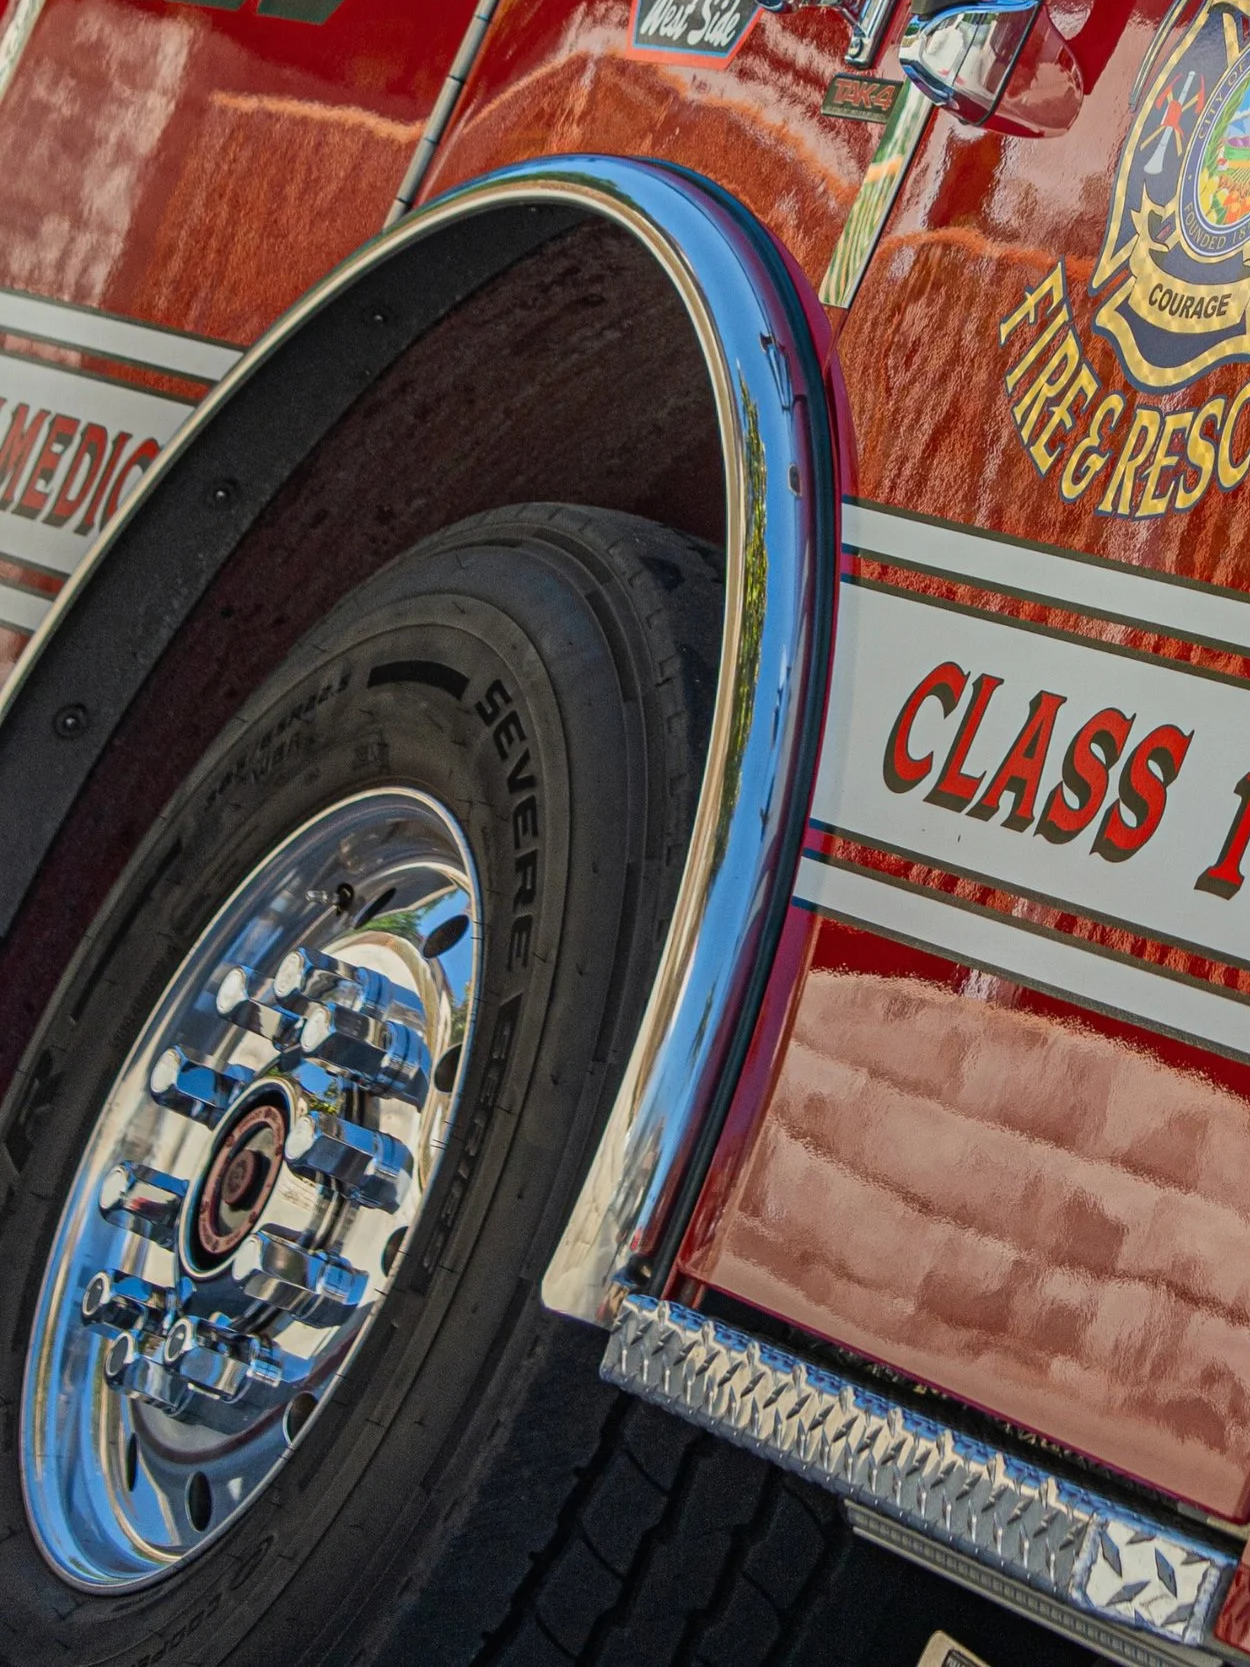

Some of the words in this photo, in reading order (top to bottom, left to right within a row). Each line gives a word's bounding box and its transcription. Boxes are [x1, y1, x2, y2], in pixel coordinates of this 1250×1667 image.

[1198, 91, 1225, 139] CITY
[1227, 61, 1247, 87] OF
[1183, 202, 1229, 252] FOUNDED
[1148, 282, 1233, 320] COURAGE
[0, 397, 165, 537] MEDIC
[882, 660, 1196, 864] CLASS
[474, 678, 541, 974] SEVERE
